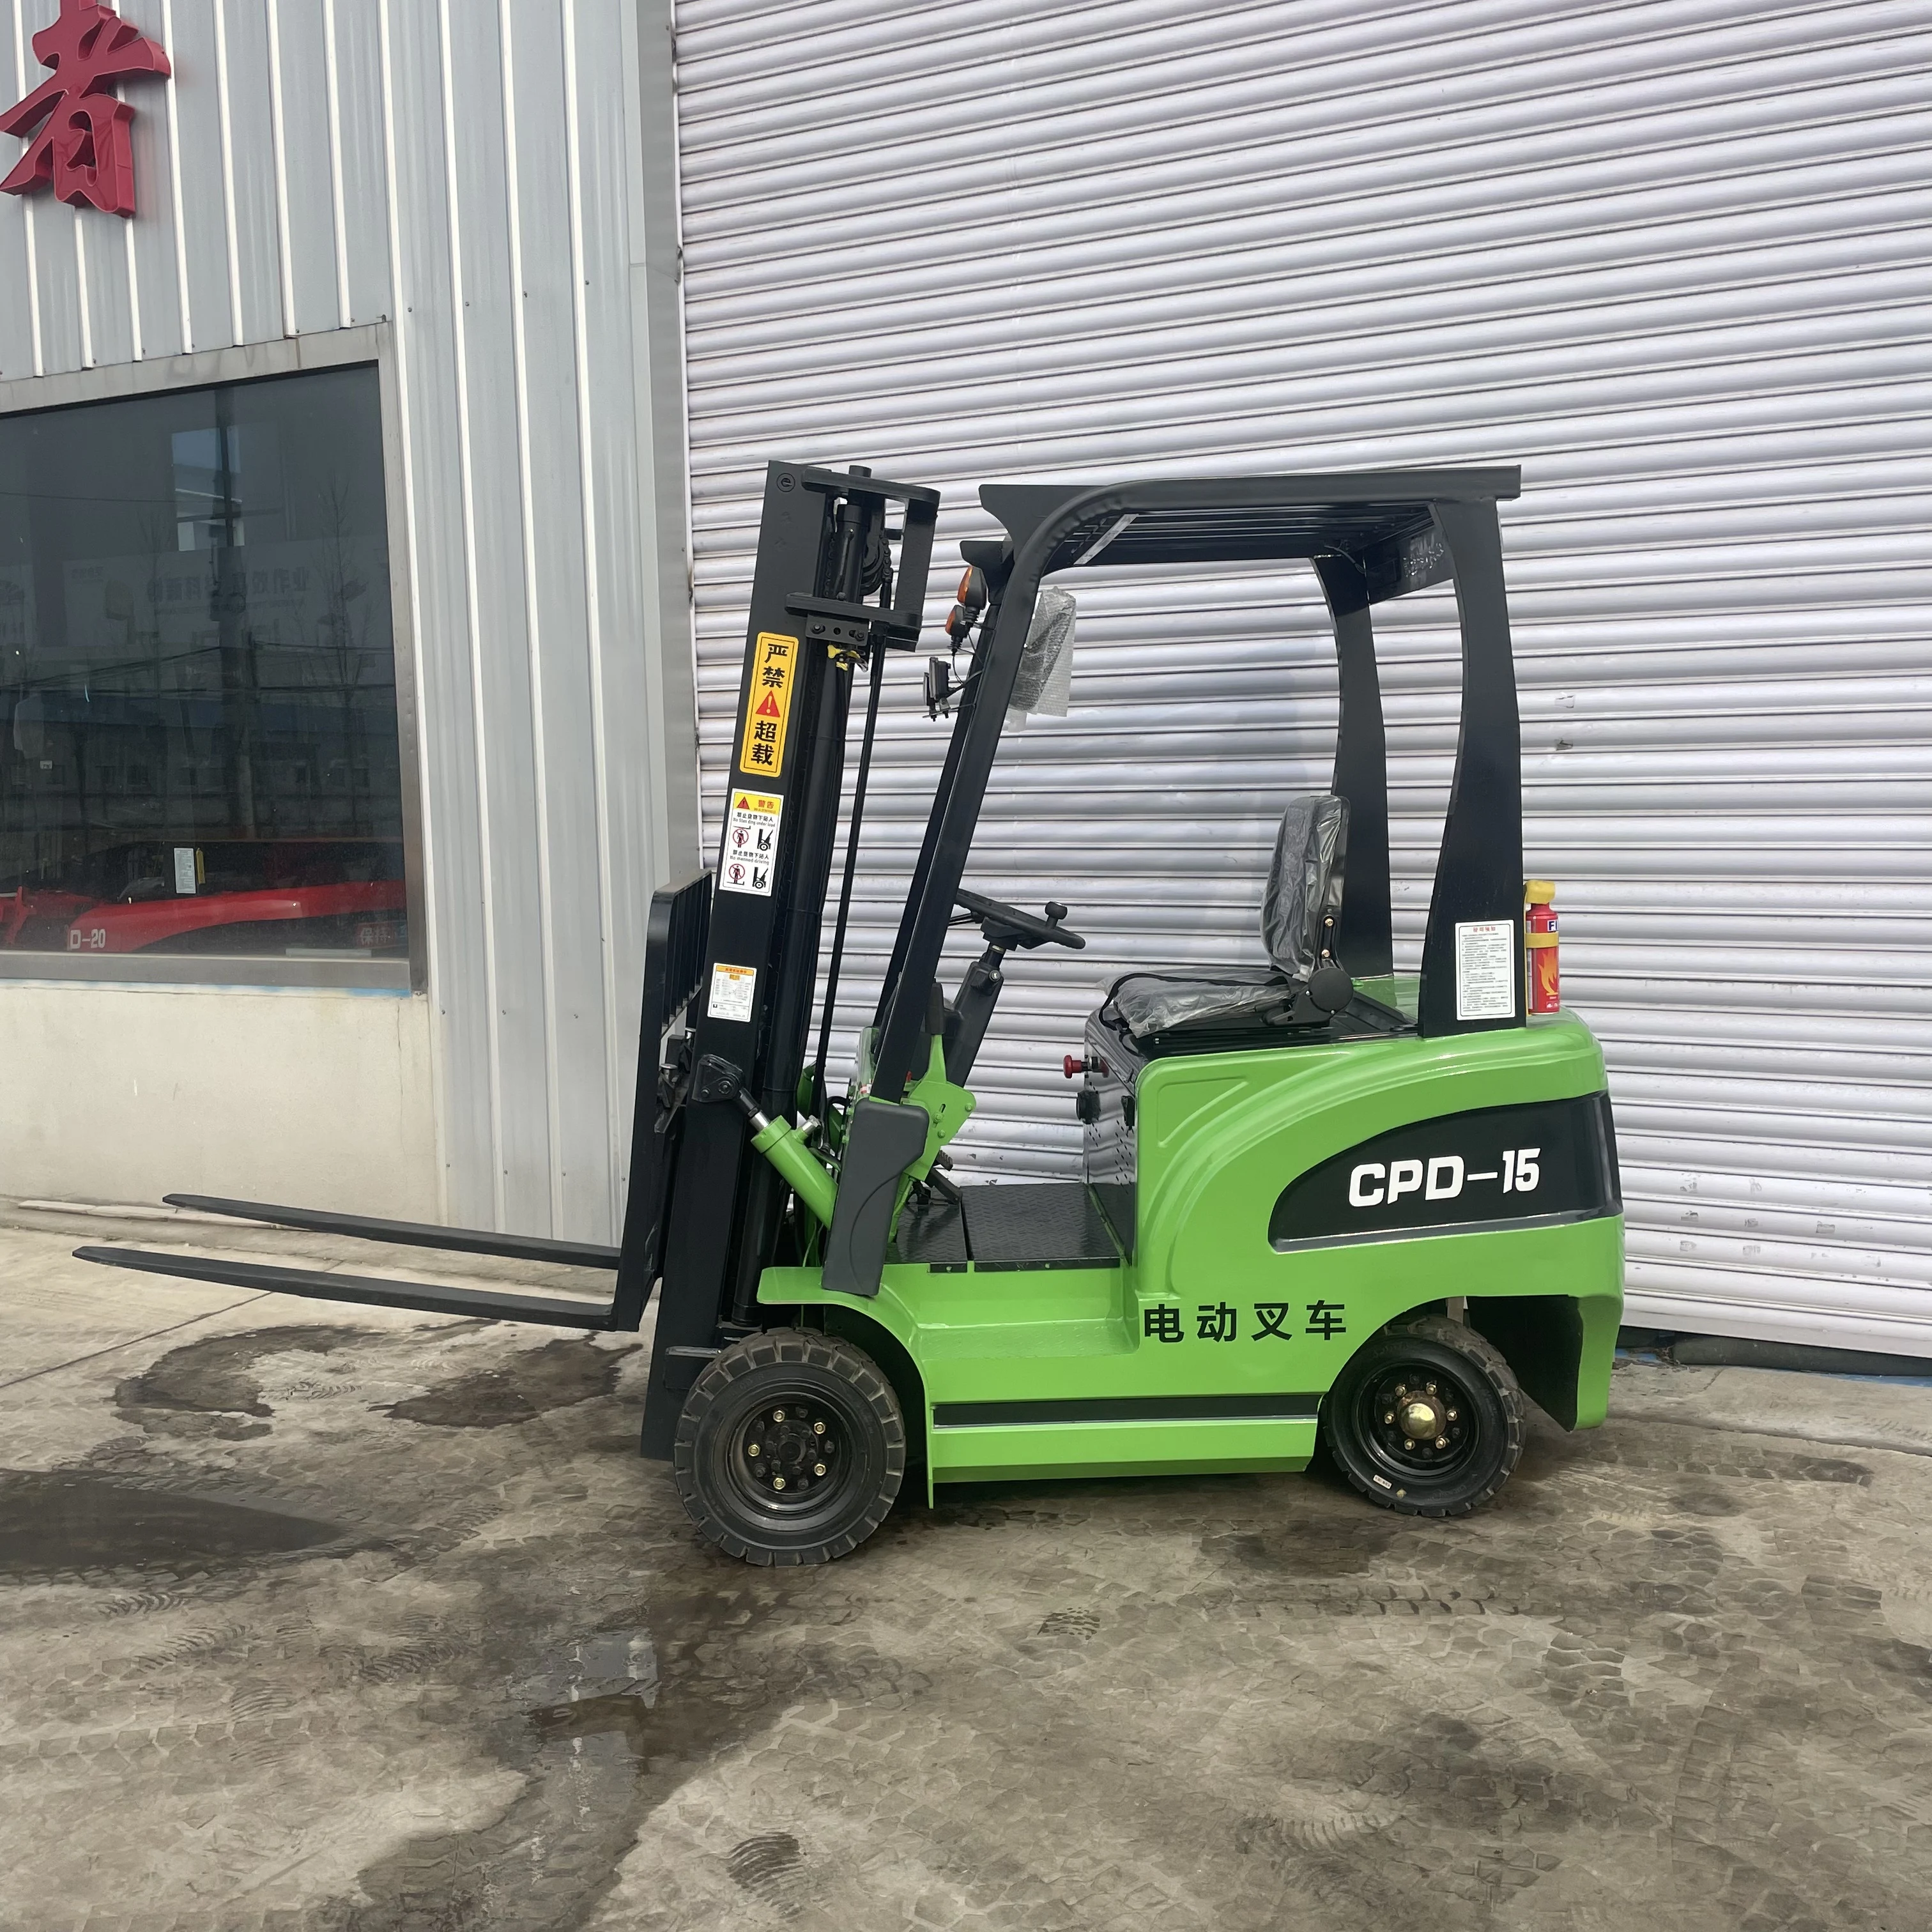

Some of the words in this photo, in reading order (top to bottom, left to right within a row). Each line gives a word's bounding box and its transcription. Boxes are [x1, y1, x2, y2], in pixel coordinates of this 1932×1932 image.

[0, 0, 171, 217] 者
[1349, 1148, 1541, 1208] CPD-15
[1144, 1300, 1347, 1342] 电动叉车
